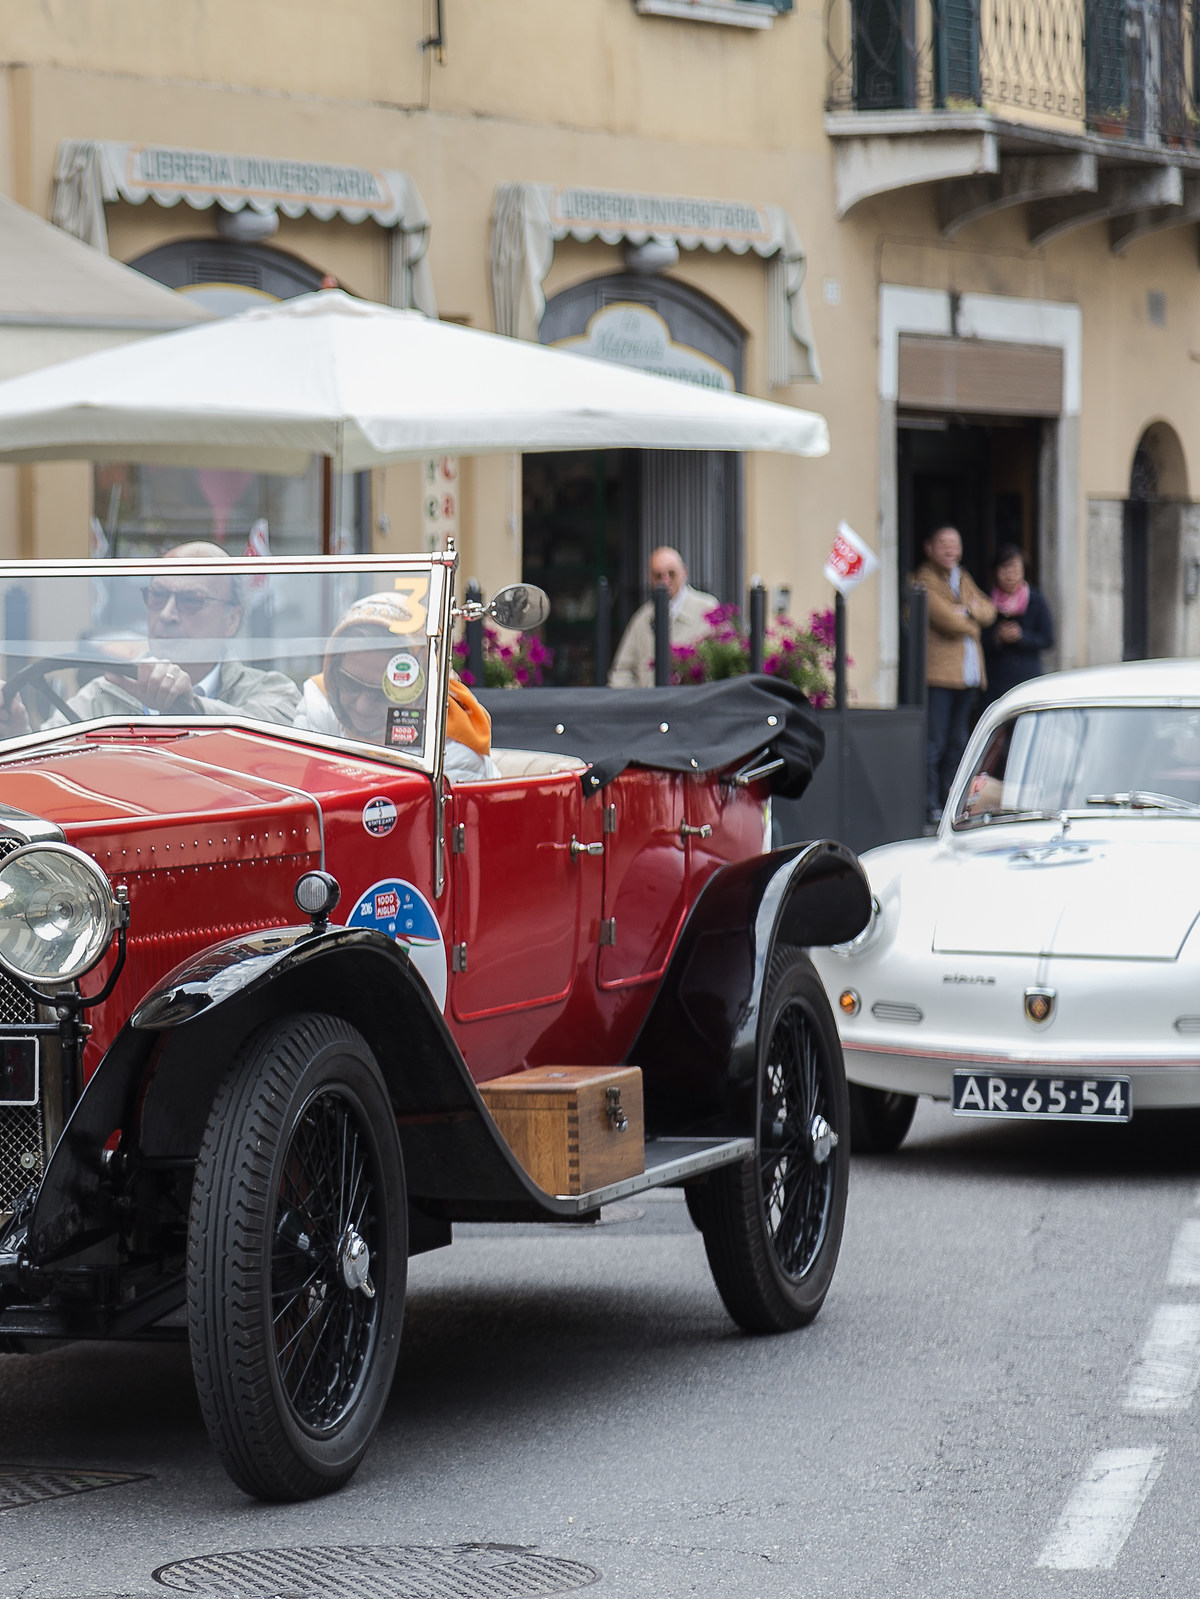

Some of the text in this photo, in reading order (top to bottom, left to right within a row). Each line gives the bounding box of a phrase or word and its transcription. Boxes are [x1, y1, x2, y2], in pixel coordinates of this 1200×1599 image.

[140, 150, 235, 185] LIBRERIA
[389, 577, 429, 634] 3
[377, 894, 394, 906] 1000
[377, 904, 396, 916] MIGLIA
